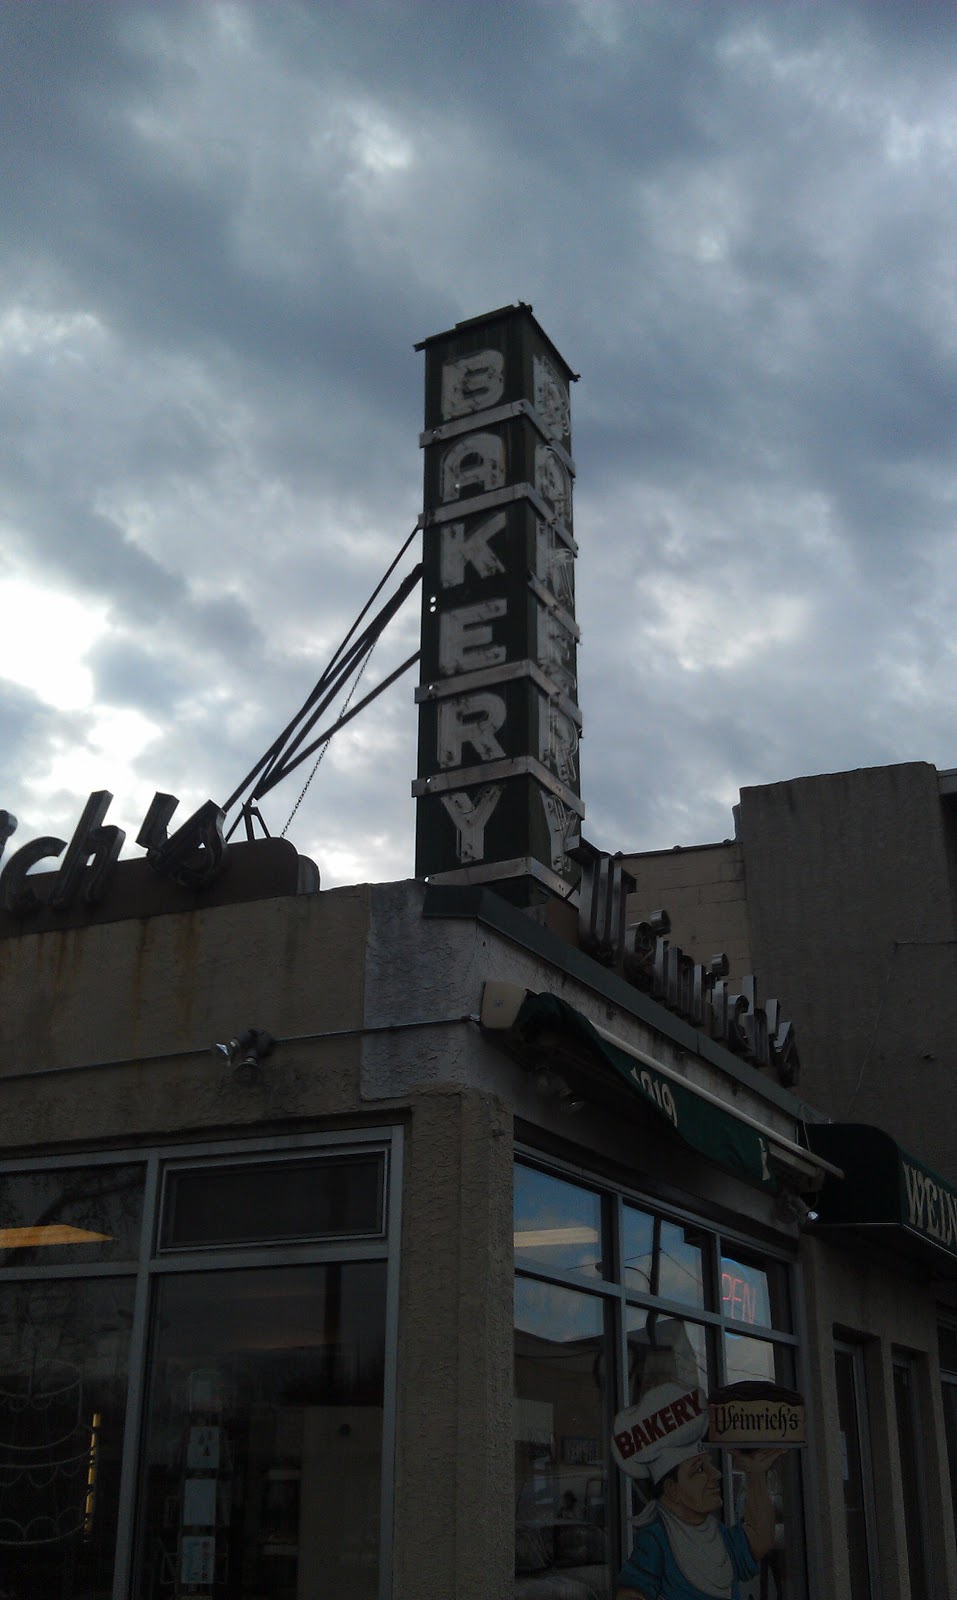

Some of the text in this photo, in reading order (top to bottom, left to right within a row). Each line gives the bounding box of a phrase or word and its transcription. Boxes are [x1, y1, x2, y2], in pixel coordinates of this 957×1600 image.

[437, 349, 507, 864] BAKERY
[722, 1272, 757, 1324] PEN
[614, 1389, 703, 1460] BAKERY
[714, 1404, 799, 1437] Weinrich's
